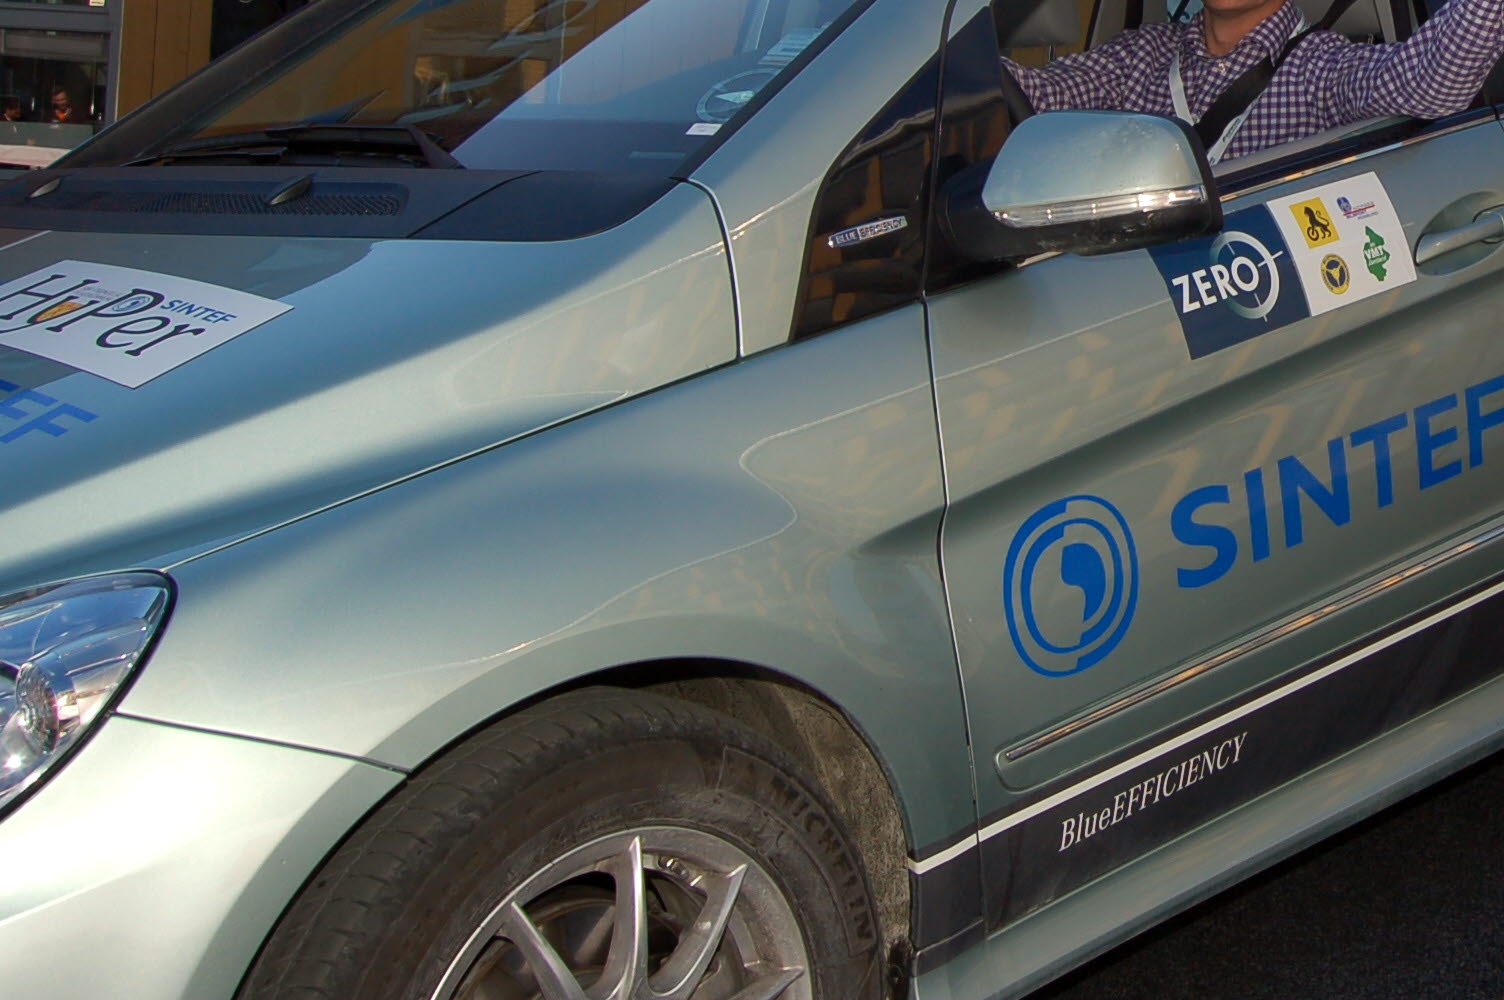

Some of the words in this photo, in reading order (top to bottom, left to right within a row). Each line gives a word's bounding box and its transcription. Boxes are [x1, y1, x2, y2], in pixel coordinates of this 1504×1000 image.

[159, 298, 238, 325] SINTEF
[1171, 255, 1260, 314] ZERO
[1058, 731, 1248, 852] BlueEFFICIENCY
